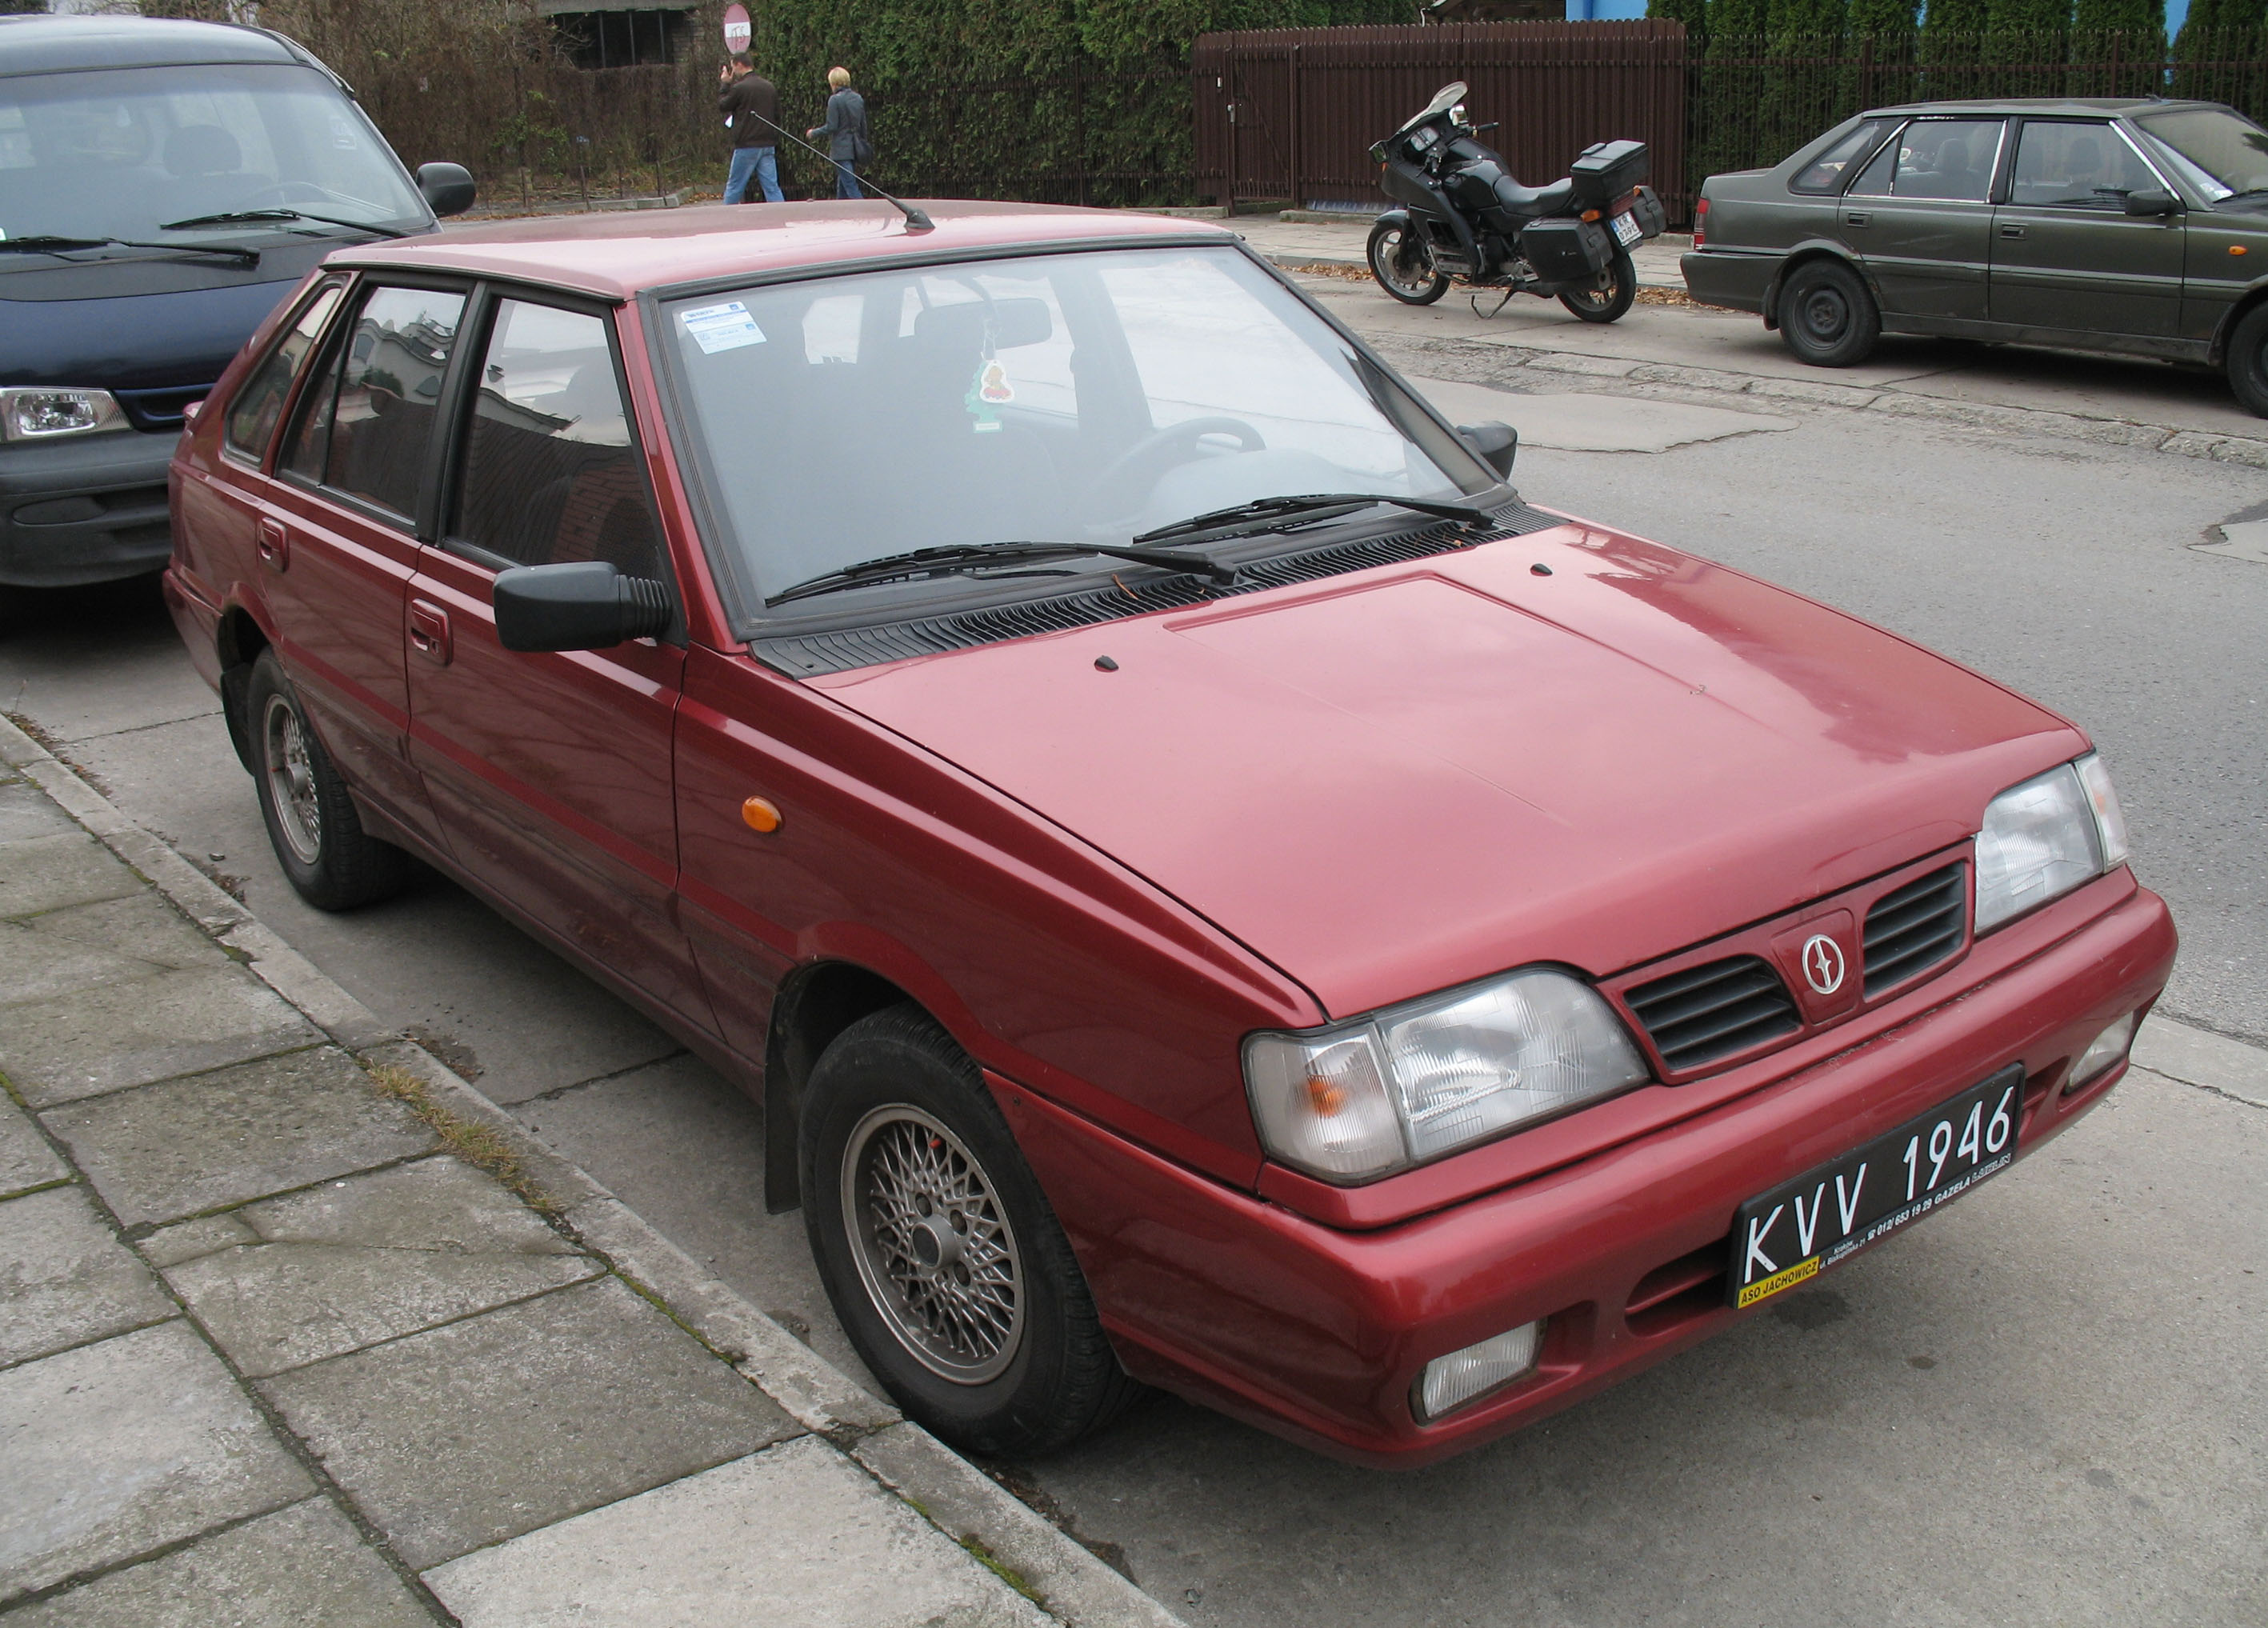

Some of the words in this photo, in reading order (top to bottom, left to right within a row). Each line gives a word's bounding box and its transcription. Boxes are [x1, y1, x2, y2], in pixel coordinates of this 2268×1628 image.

[1744, 1162, 1867, 1284] KVV
[1902, 1086, 2014, 1202] 1946
[1911, 1203, 1922, 1217] 19
[1934, 1176, 1970, 1205] GAZELA
[1741, 1286, 1761, 1304] ASO
[1763, 1261, 1818, 1294] JACHOWICZ
